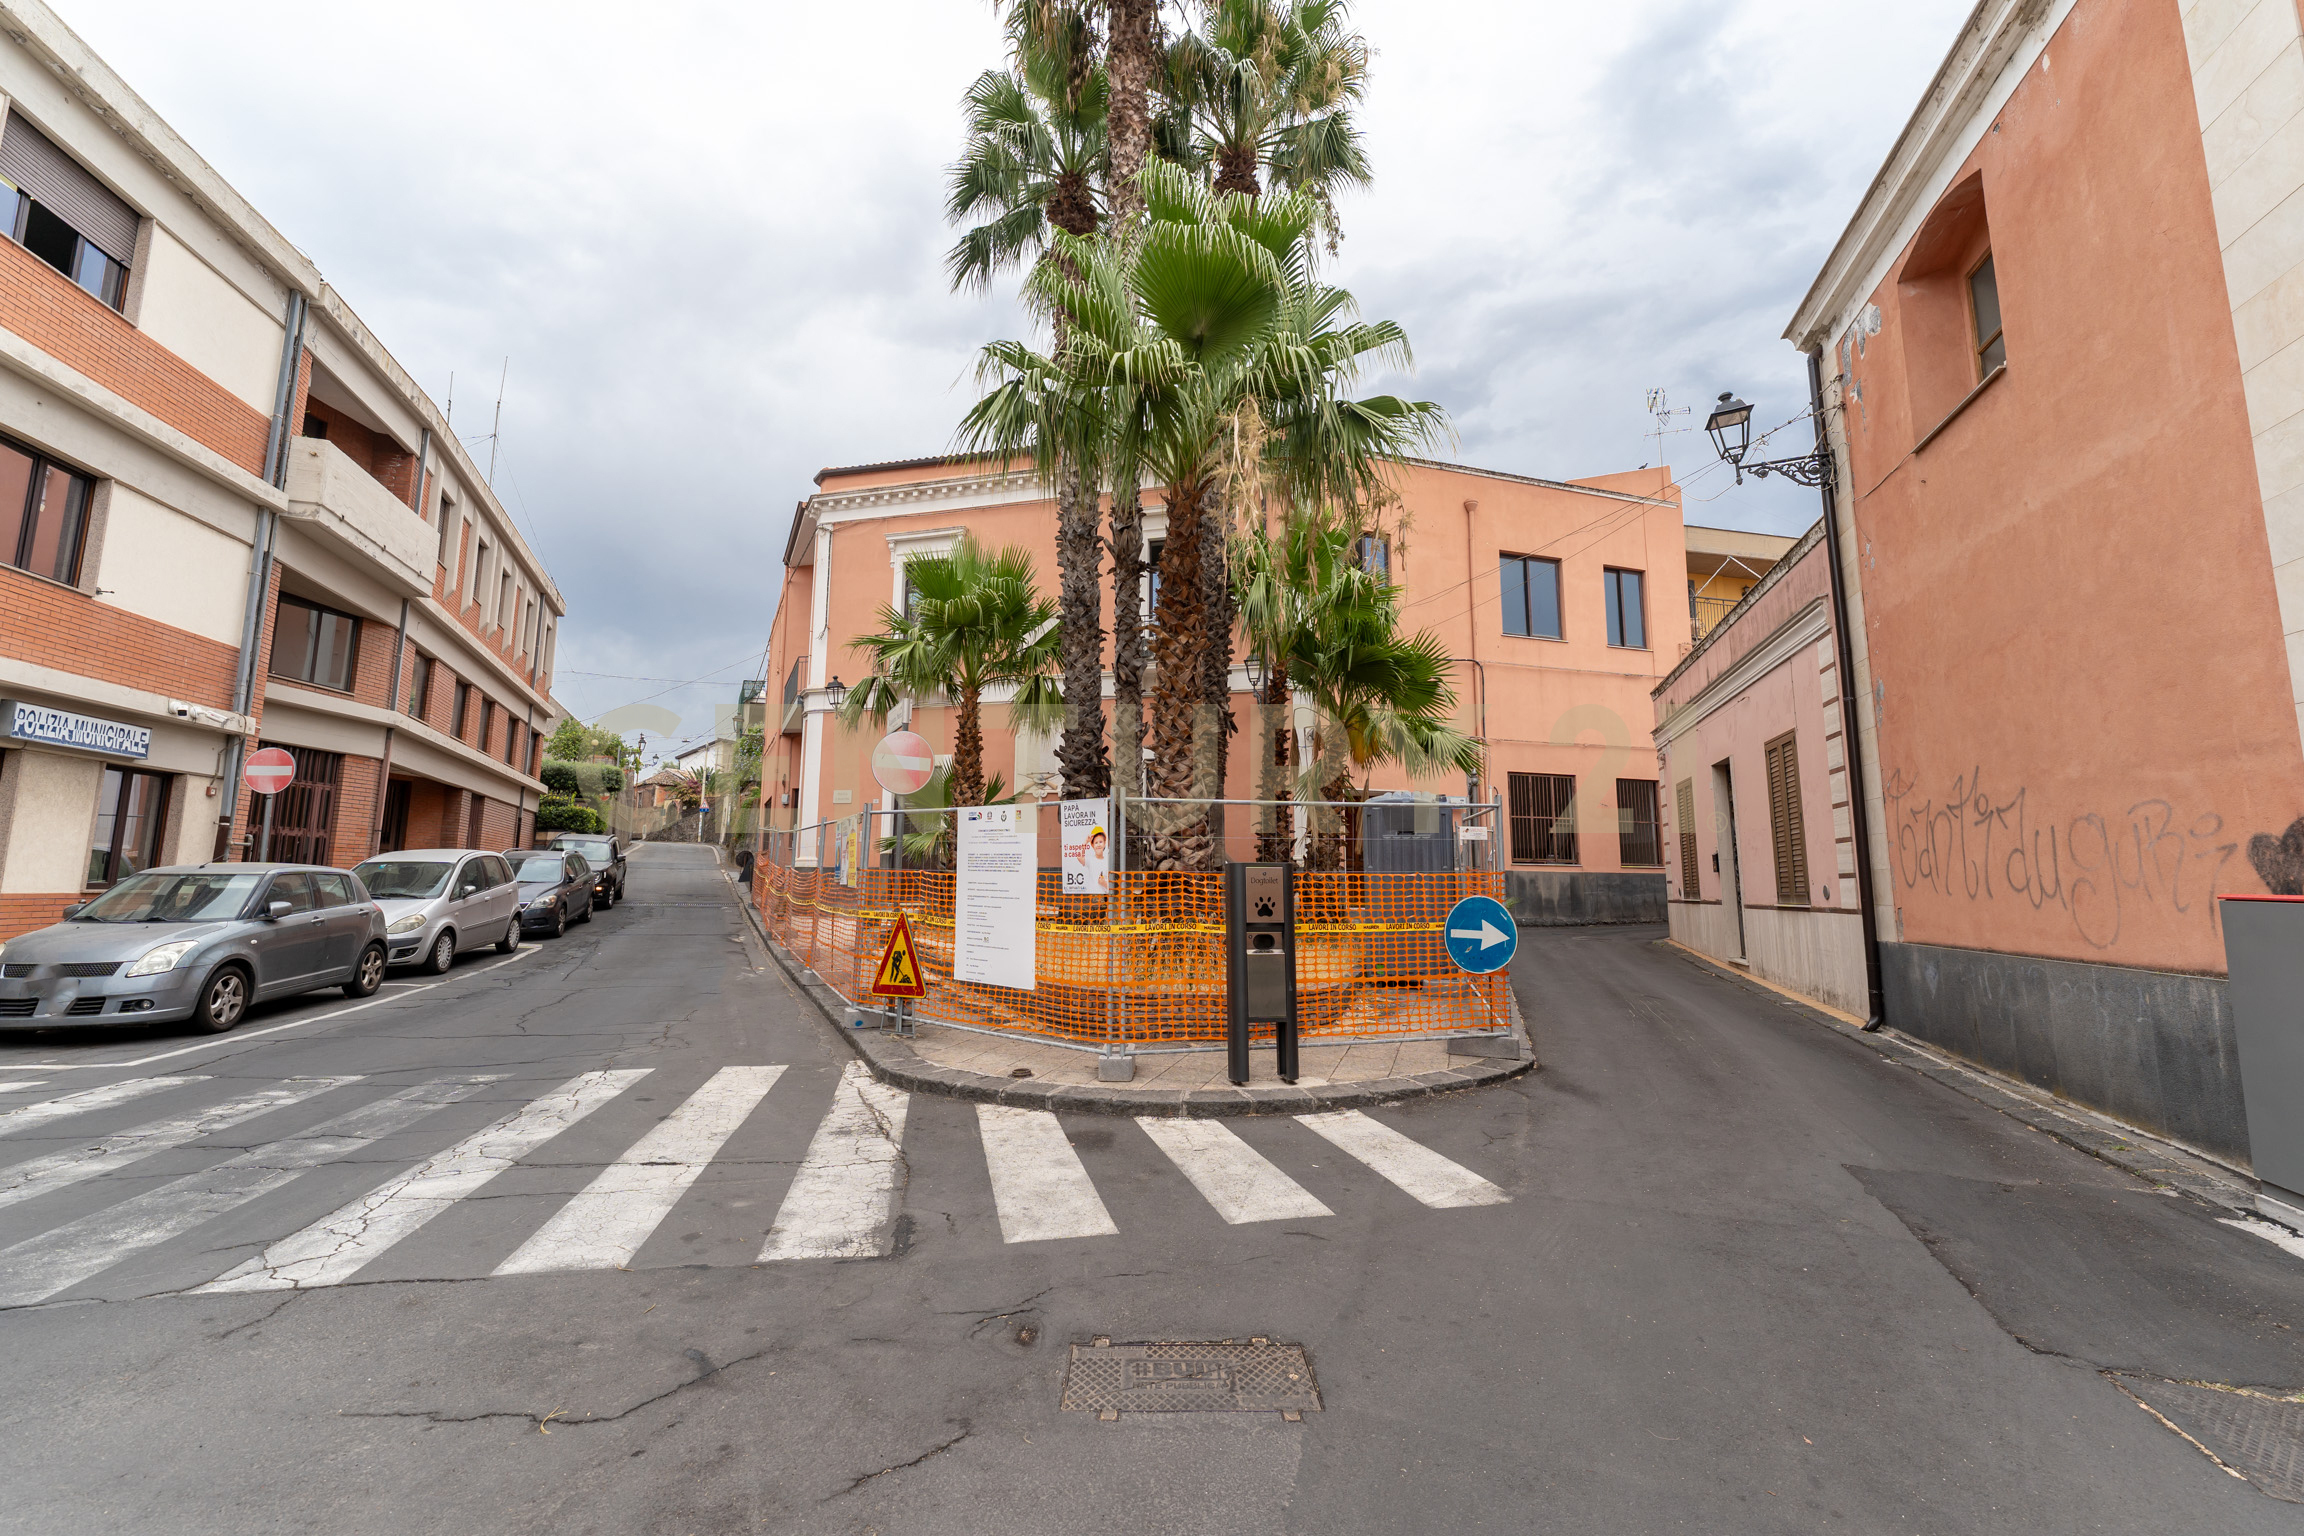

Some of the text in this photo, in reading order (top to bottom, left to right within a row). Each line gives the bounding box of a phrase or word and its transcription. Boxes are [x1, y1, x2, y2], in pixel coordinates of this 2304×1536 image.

[13, 708, 148, 754] POLIZIA MUNICIPALE
[1064, 803, 1080, 812] PAPÀ
[1064, 812, 1088, 820] LAVORA
[1069, 844, 1090, 852] aspetto
[1251, 877, 1278, 885] Dogtoilet
[1037, 922, 1051, 930] CORSO
[1165, 1382, 1224, 1390] PUBBLICA
